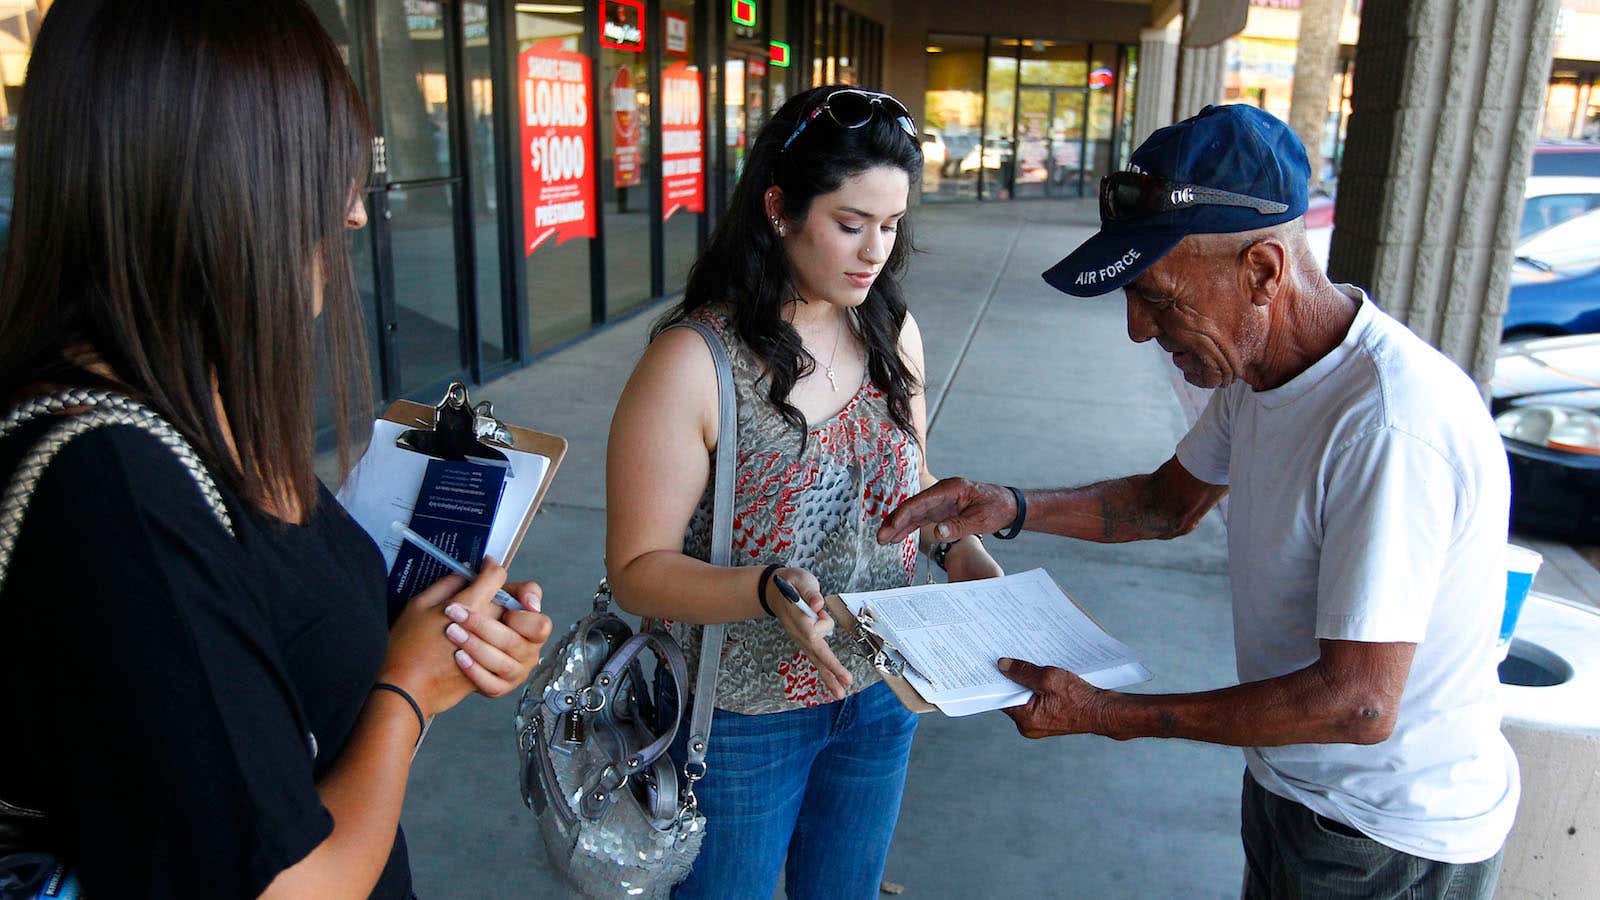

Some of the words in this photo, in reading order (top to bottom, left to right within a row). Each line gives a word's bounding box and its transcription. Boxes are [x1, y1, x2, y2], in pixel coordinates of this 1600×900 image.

[525, 79, 587, 127] LOANS
[530, 135, 585, 185] $1,000
[1075, 271, 1097, 285] AIR
[1100, 248, 1142, 281] FORCE
